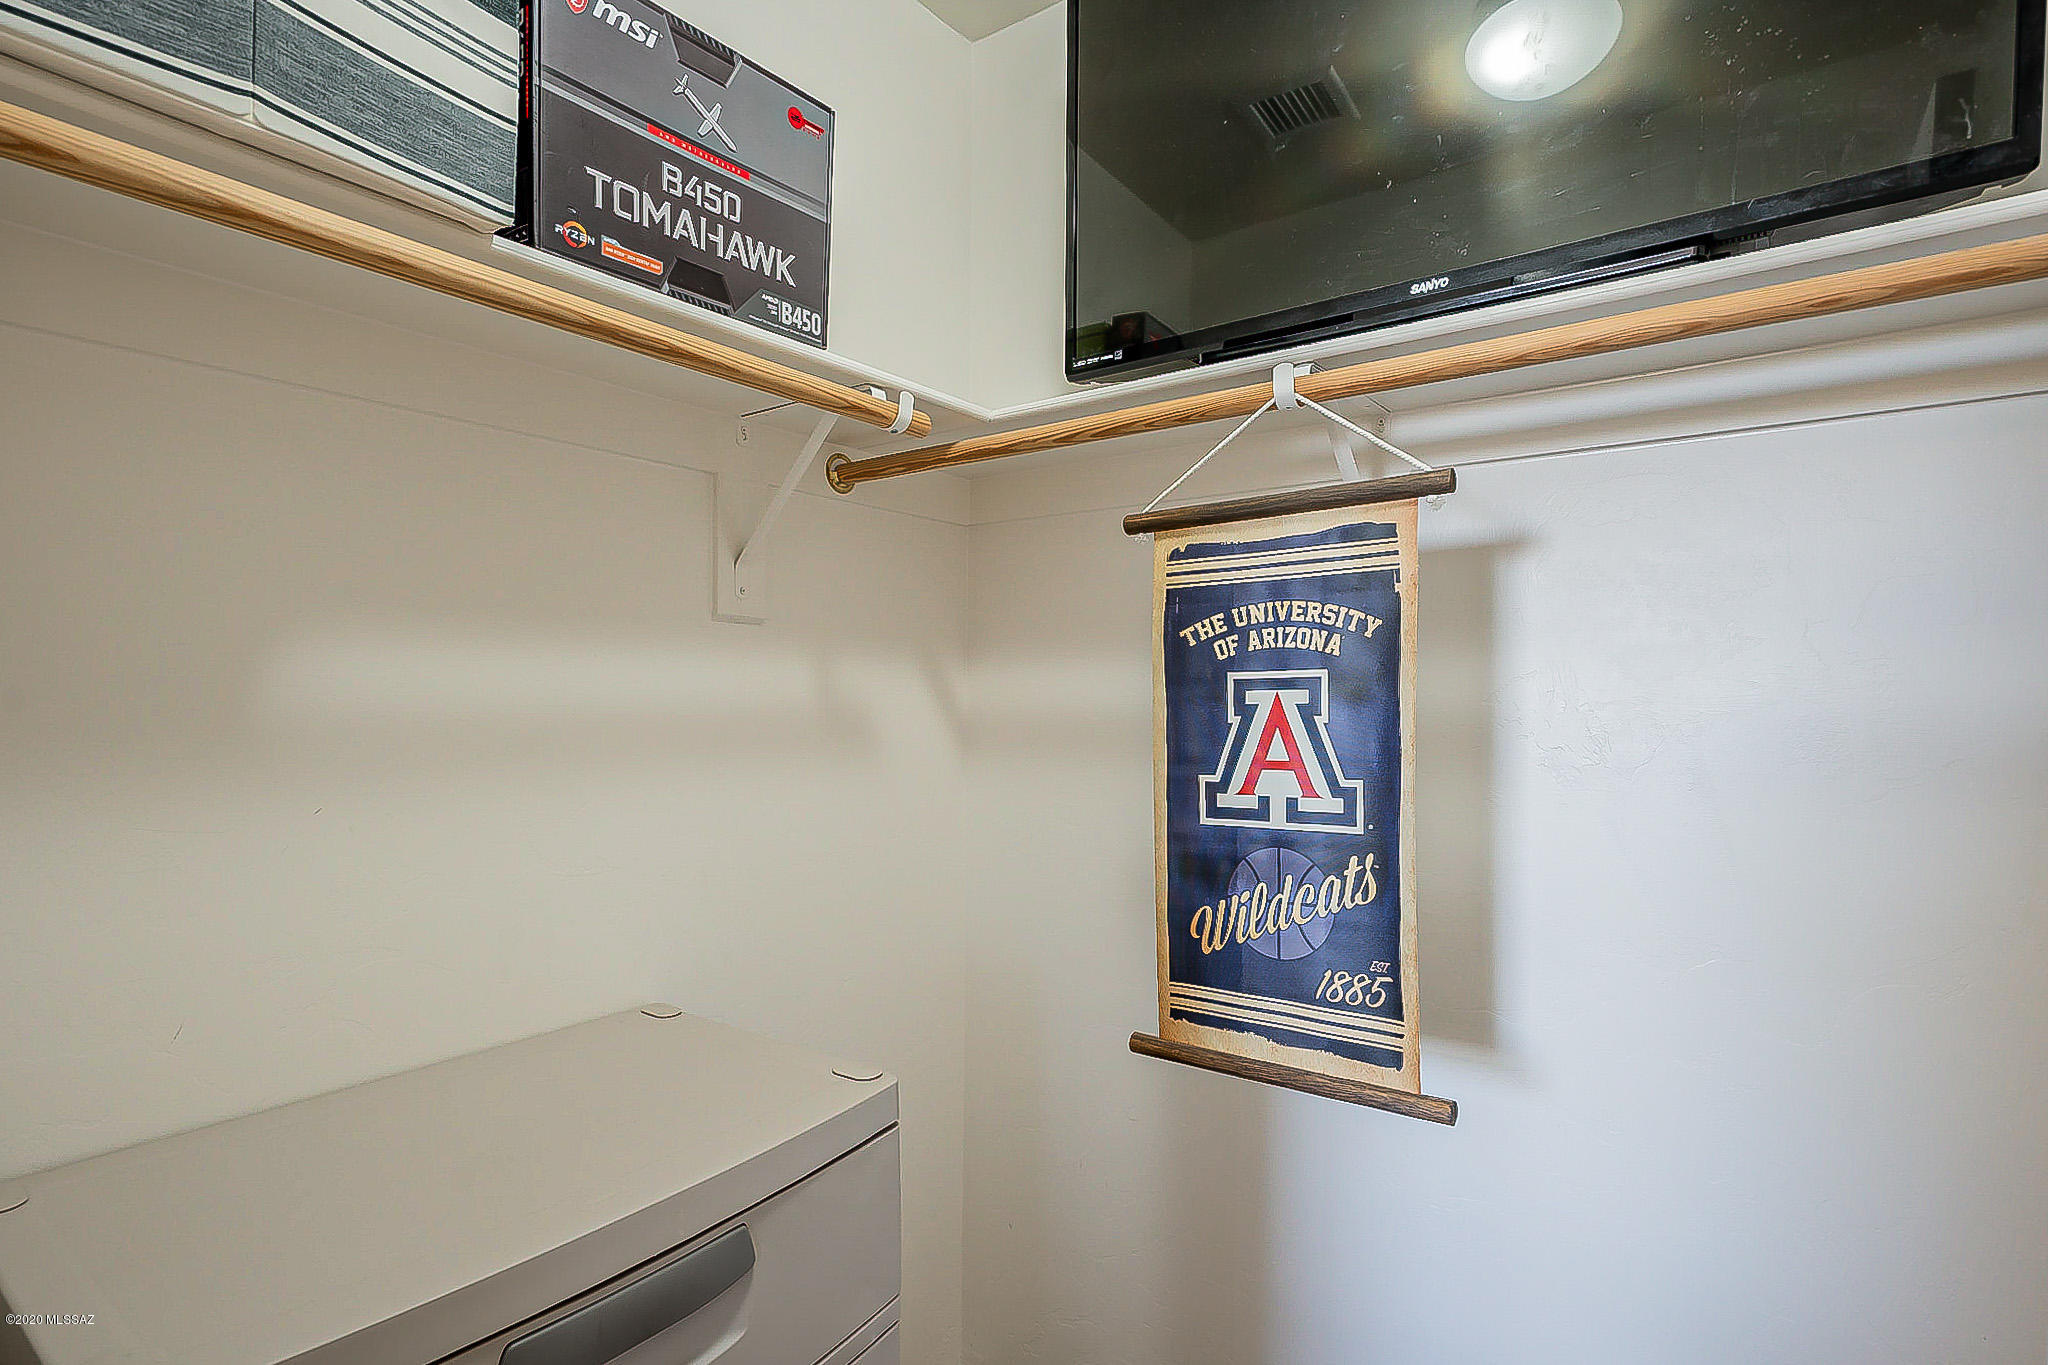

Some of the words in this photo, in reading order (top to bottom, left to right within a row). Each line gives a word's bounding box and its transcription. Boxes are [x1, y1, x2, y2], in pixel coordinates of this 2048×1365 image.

[592, 0, 660, 49] msi
[661, 159, 742, 224] B450
[554, 222, 596, 246] RYZEN
[584, 165, 797, 288] TOMAHAWK
[1409, 276, 1449, 295] SANYO
[781, 301, 822, 336] B450
[1179, 612, 1228, 647] THE
[1231, 600, 1383, 638] UNIVERSITY
[1213, 634, 1240, 661] OF
[1247, 627, 1342, 657] ARIZONA
[1198, 668, 1365, 835] A
[1190, 852, 1378, 954] Wildcats
[1315, 968, 1394, 1008] 1885
